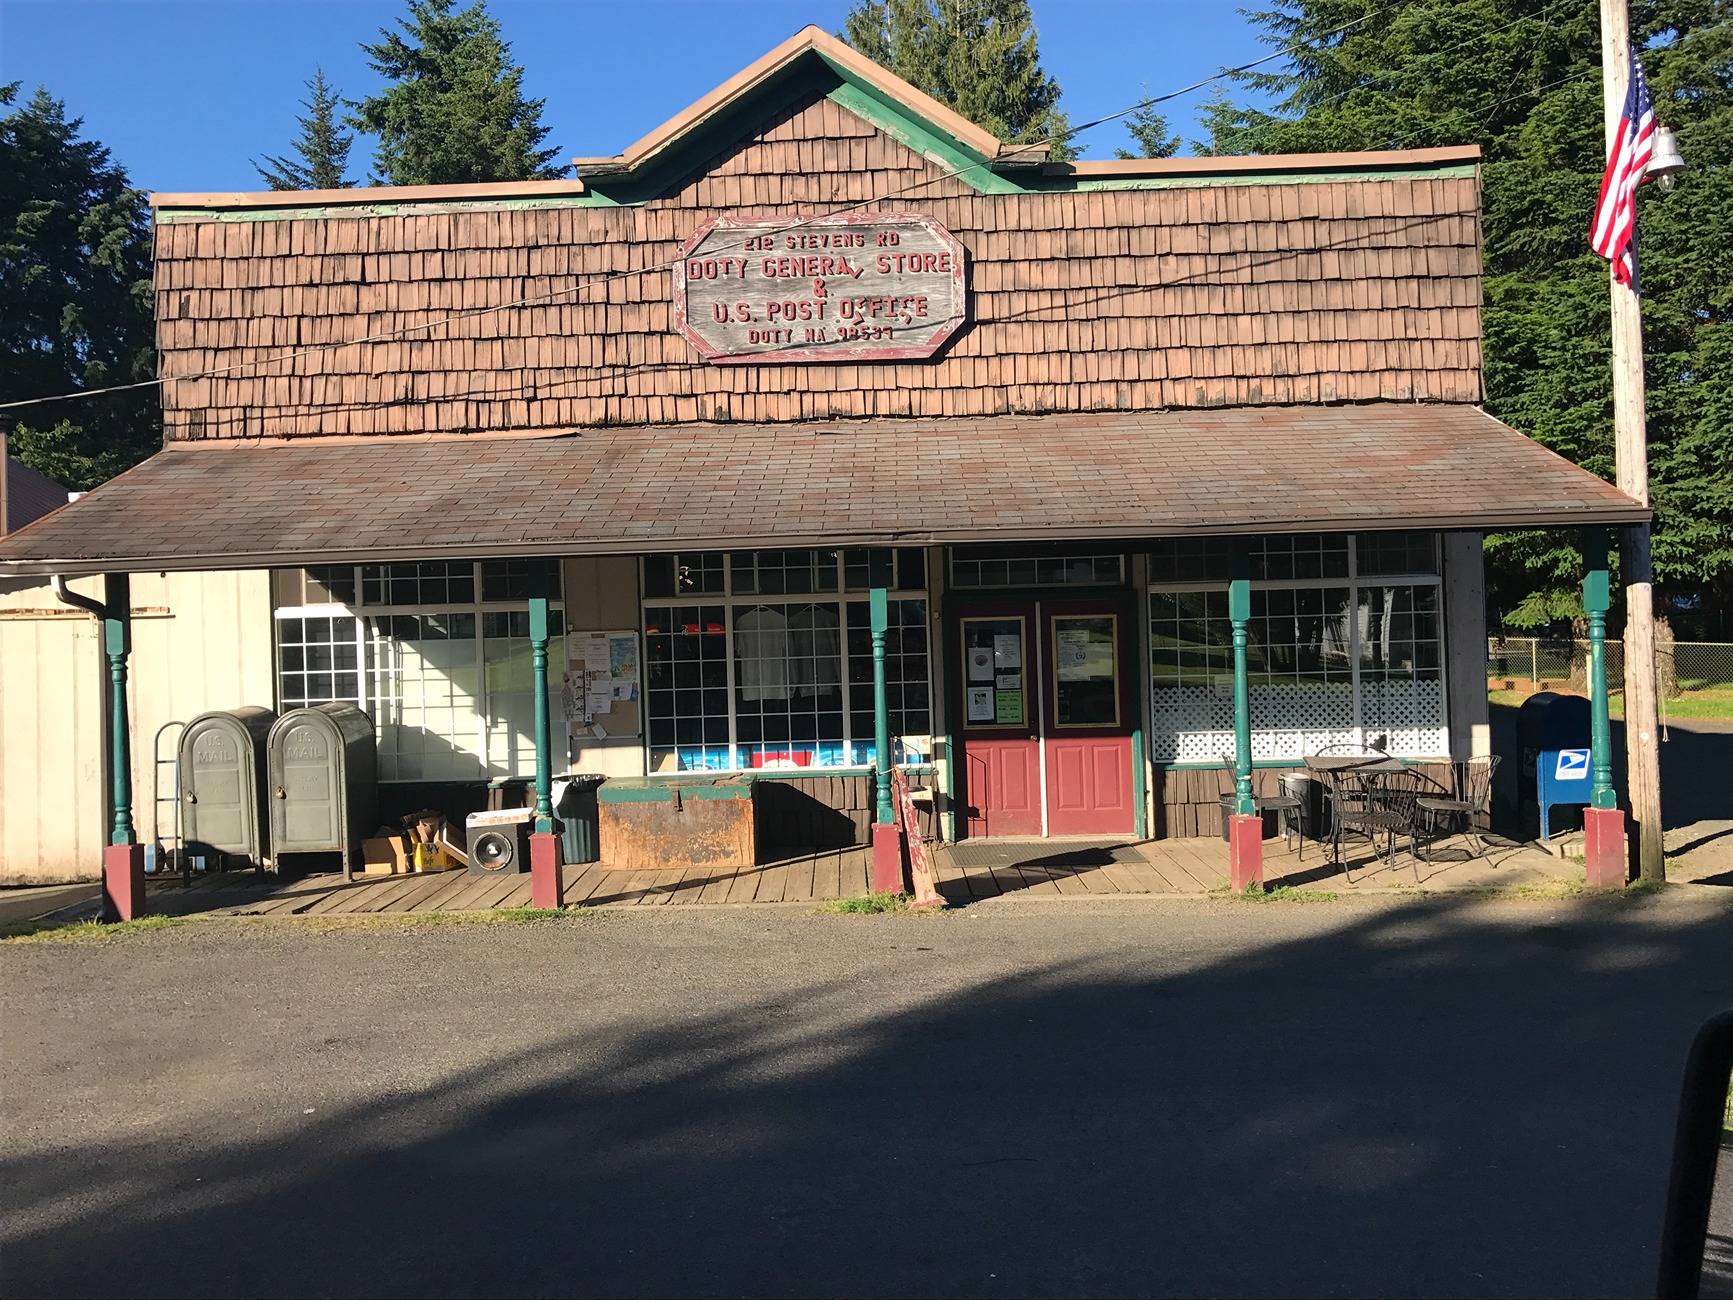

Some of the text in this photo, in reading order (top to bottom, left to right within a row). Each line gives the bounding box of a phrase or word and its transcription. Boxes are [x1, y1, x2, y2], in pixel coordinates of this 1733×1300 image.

[743, 230, 900, 252] 212 STEVENS RD
[687, 251, 952, 281] DOTY GENERAL STORE
[811, 277, 828, 299] &
[712, 294, 929, 326] U.S. POST OFFICE
[748, 328, 793, 344] DOTY
[198, 750, 234, 763] MAIL
[288, 746, 324, 760] MAIL
